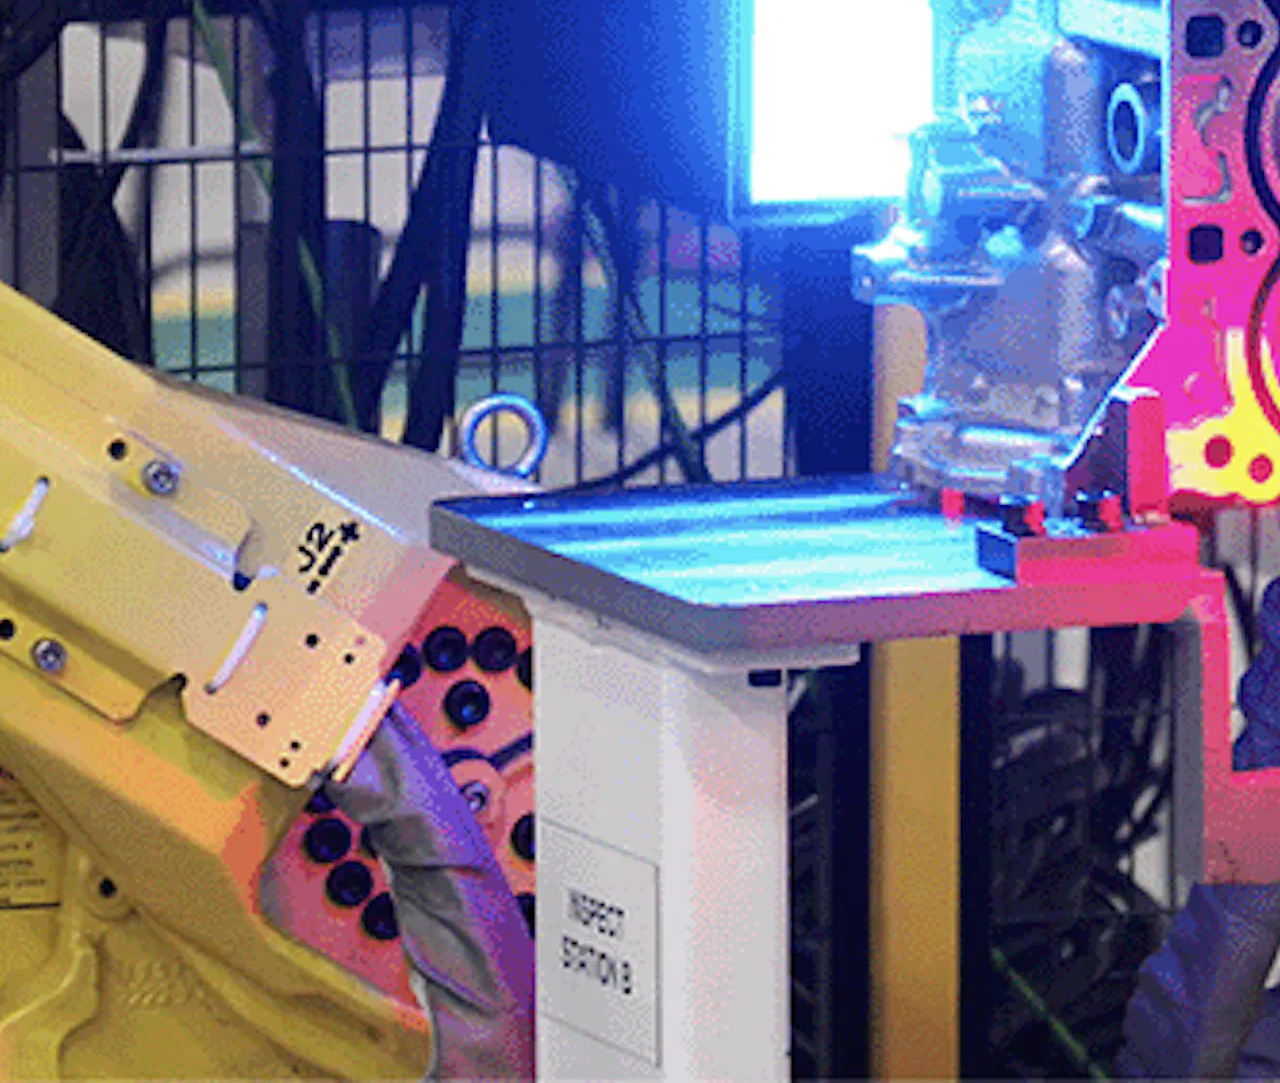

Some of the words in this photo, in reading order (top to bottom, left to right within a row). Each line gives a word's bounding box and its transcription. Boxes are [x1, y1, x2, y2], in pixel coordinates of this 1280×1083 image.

[298, 523, 335, 573] J2
[568, 889, 624, 939] INSPECT
[563, 935, 618, 989] STATION
